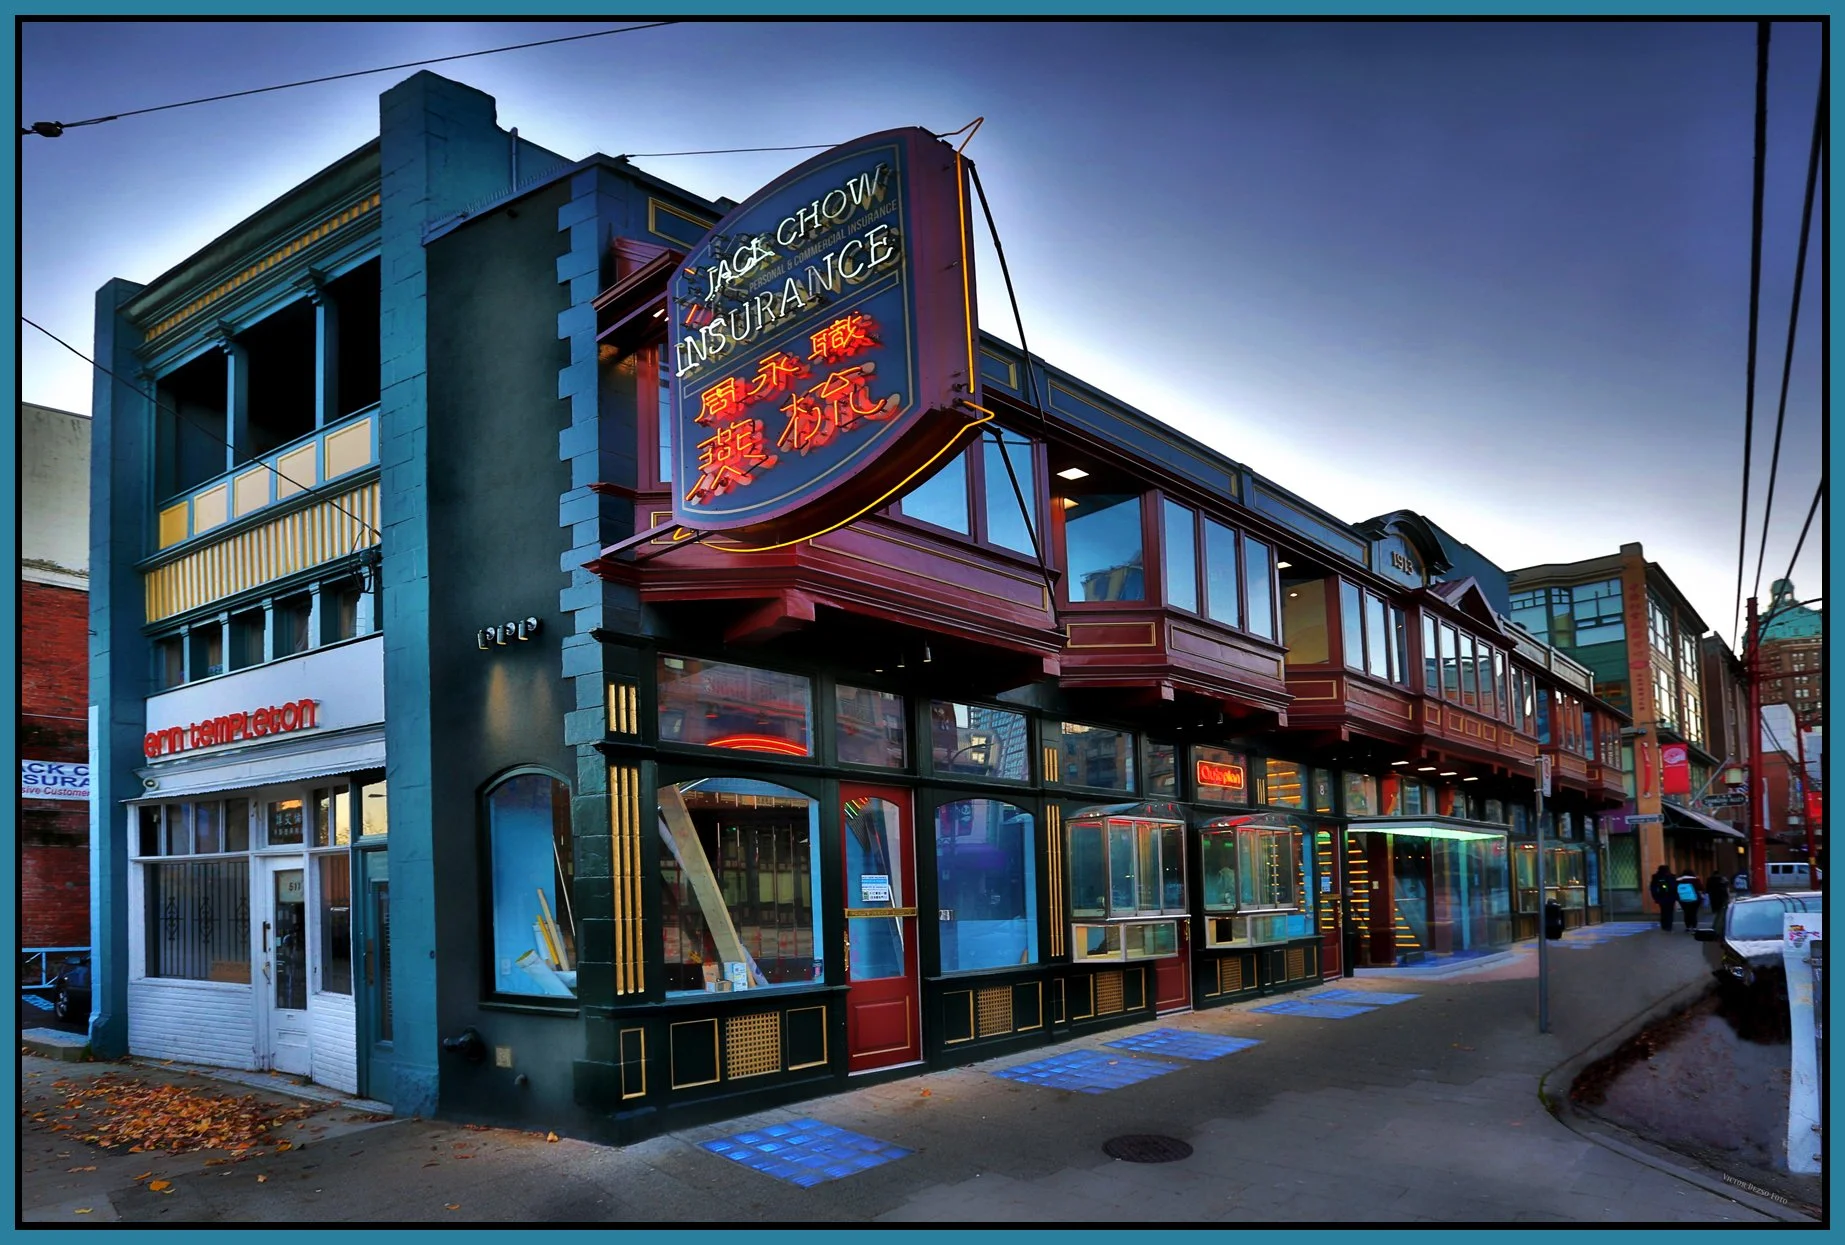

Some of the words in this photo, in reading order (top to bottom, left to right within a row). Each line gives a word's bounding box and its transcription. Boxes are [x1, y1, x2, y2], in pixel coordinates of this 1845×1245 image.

[704, 238, 775, 301] JACK
[777, 163, 887, 246] CHOW
[750, 262, 787, 292] PERSONAL
[787, 260, 795, 272] &
[794, 228, 847, 266] COMMERCIAL
[847, 200, 897, 237] INSURANCE
[675, 224, 894, 378] INSURANCE
[1391, 551, 1413, 576] 1913
